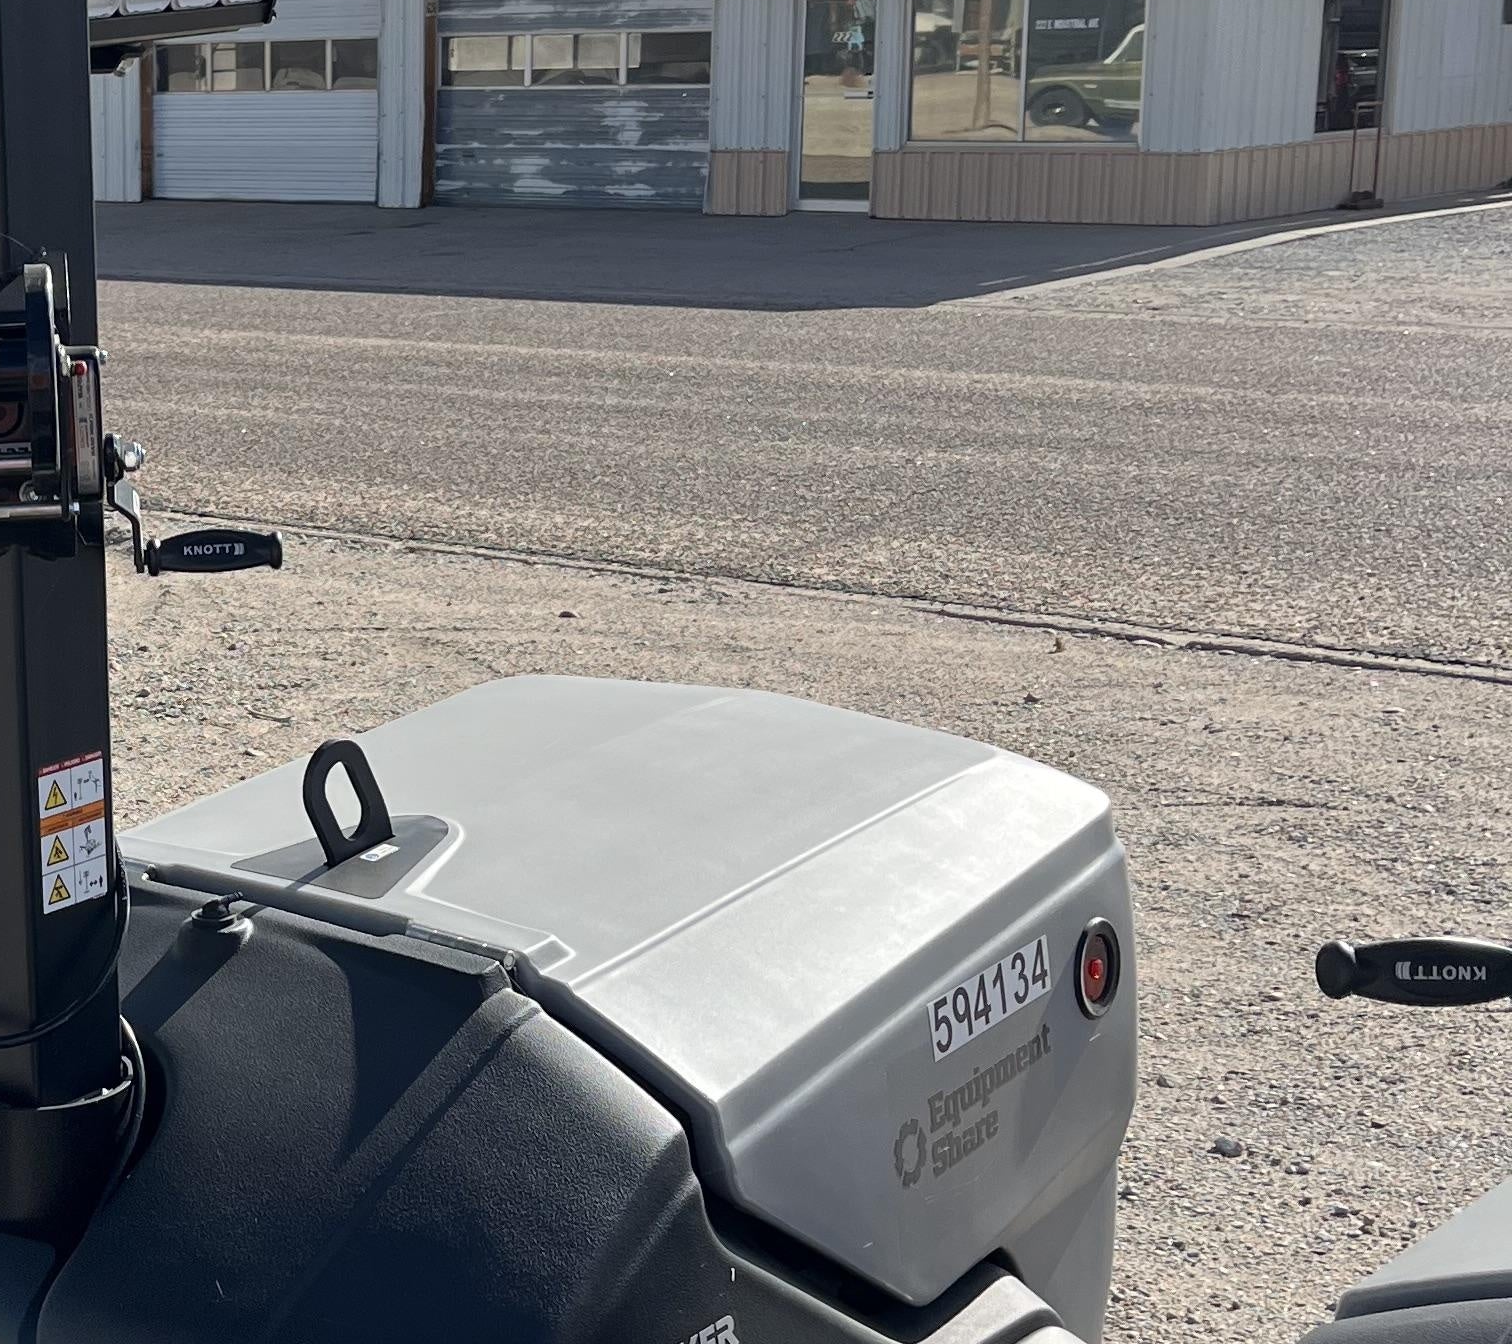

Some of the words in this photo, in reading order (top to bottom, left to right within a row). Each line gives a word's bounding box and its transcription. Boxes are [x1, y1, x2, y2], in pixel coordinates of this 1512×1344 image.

[183, 543, 232, 556] KNOTT
[934, 939, 1048, 1053] 594134
[1414, 965, 1487, 981] KNOTT
[927, 1023, 1051, 1133] Equipment
[931, 1109, 999, 1178] Share
